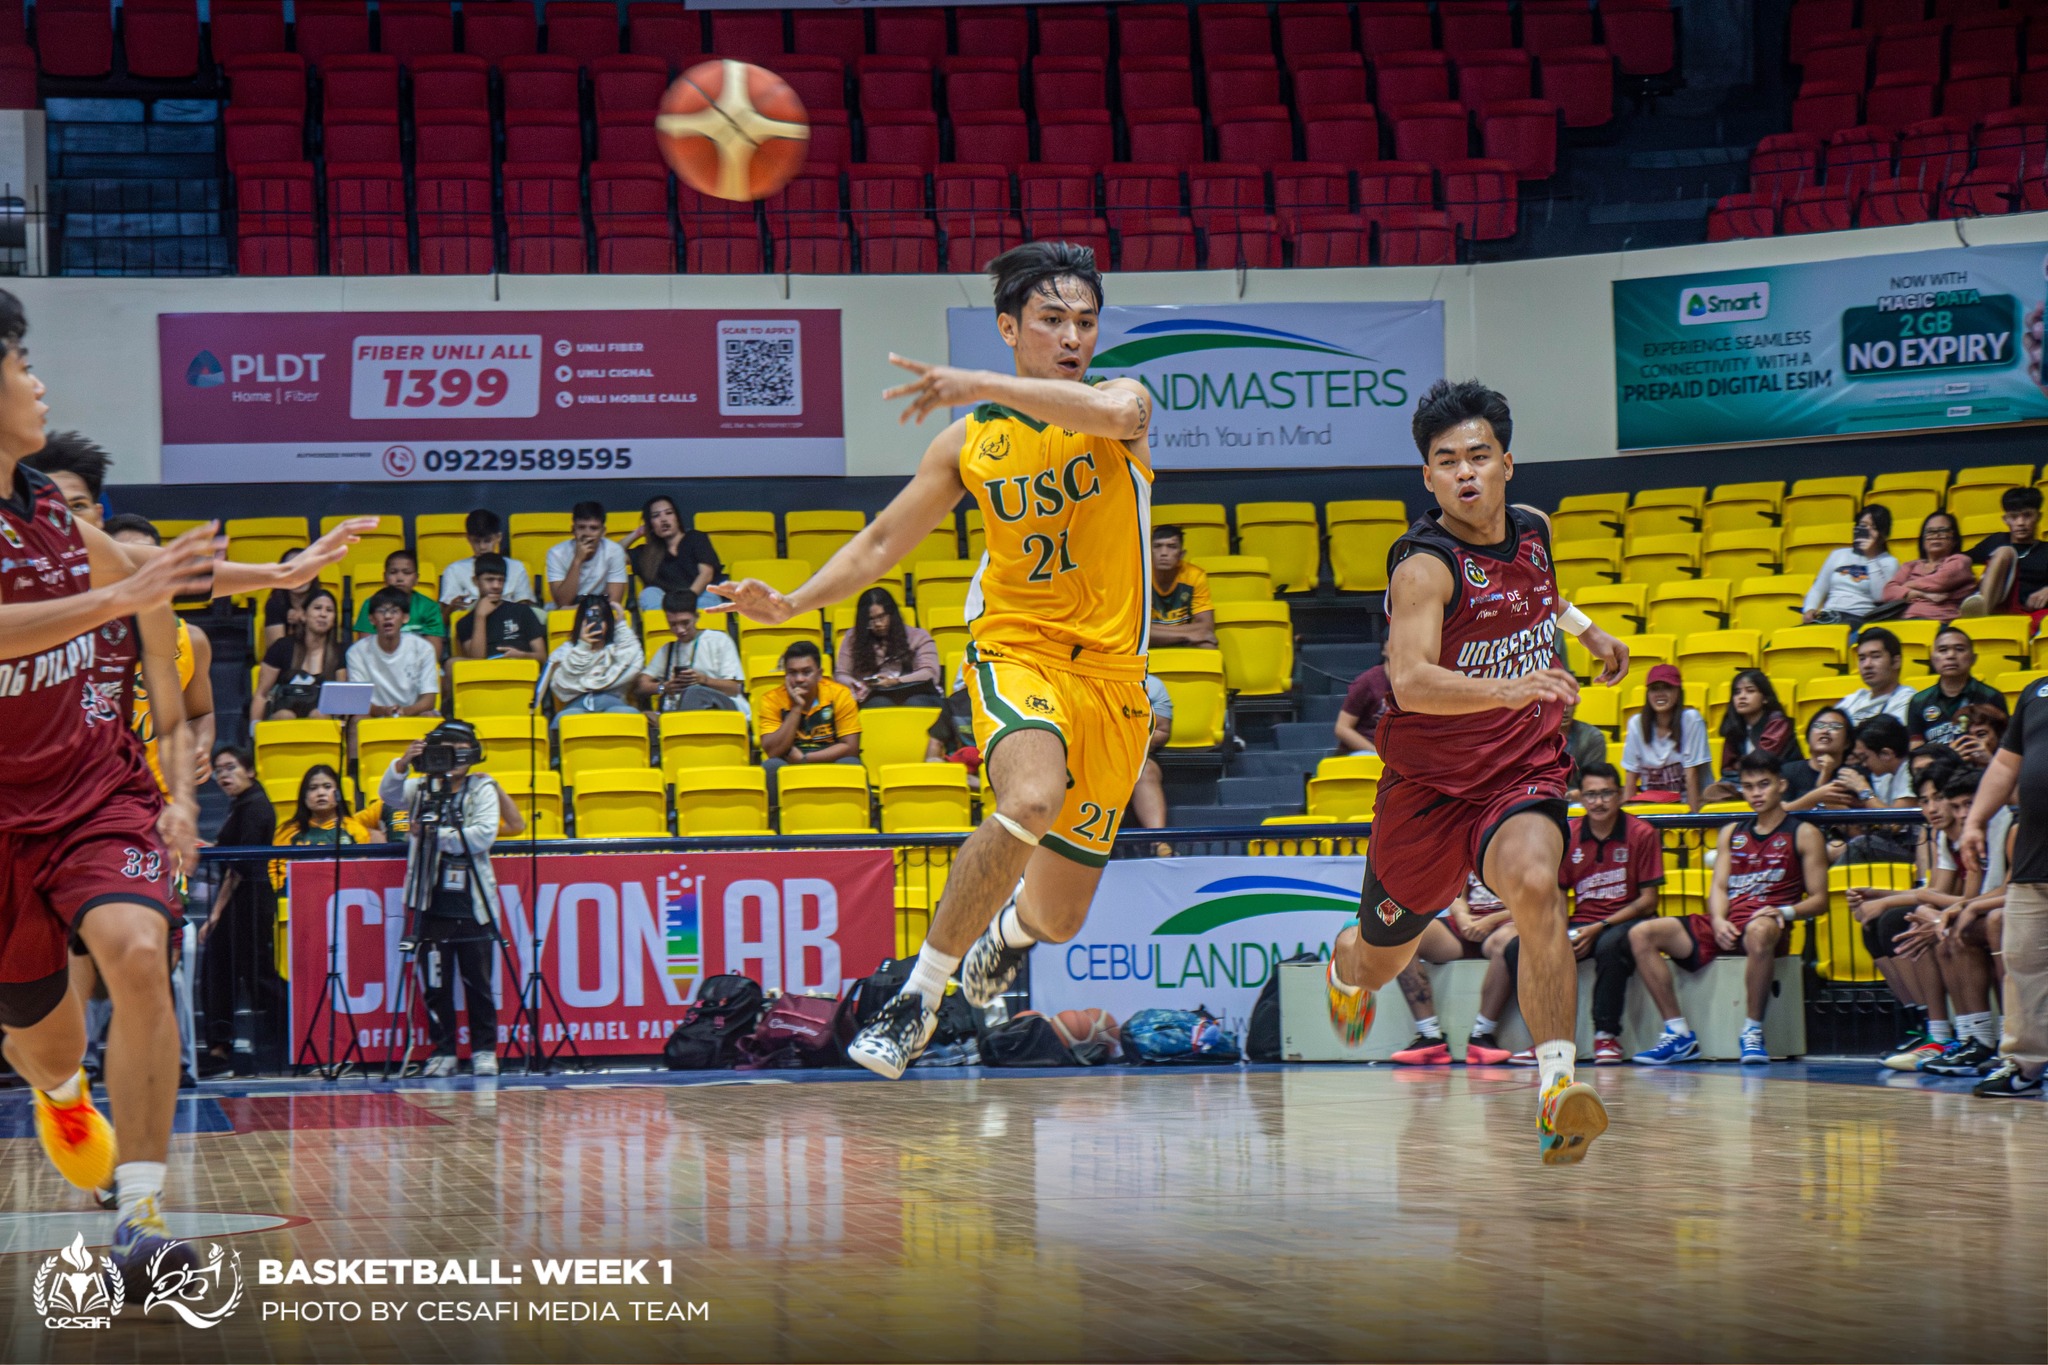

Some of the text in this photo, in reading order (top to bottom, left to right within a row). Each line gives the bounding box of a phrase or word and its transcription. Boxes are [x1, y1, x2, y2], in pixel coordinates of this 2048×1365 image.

[1890, 271, 1968, 290] NOW WITH
[1707, 291, 1762, 313] Smart
[721, 327, 797, 335] SCAN TO APPLY
[1643, 330, 1812, 358] EXPERIENCE SEAMLESS
[357, 344, 533, 361] FIBER UNLI ALL
[576, 342, 645, 352] UNLI FIBER
[1849, 331, 2011, 371] NO EXPIRY
[231, 353, 326, 383] PLDT
[577, 369, 606, 379] UNLI
[1640, 352, 1812, 379] CONNECTIVITY WITH A
[231, 390, 320, 403] Home Fiber
[382, 367, 510, 408] 1399
[578, 393, 698, 404] UNLI MOBILE CALLS
[1140, 368, 1409, 411] NDMASTERS
[1622, 369, 1834, 404] PREPAID DIGITAL ESIM
[1164, 426, 1210, 448] with
[1215, 426, 1252, 447] You
[1256, 427, 1274, 446] in
[1279, 423, 1332, 446] Mind
[424, 448, 632, 473] 09229589595
[984, 452, 1101, 523] USC
[1022, 528, 1078, 583] 21
[1071, 801, 1118, 843] 21
[327, 881, 670, 1014] CYON
[542, 1021, 629, 1042] APPAREL
